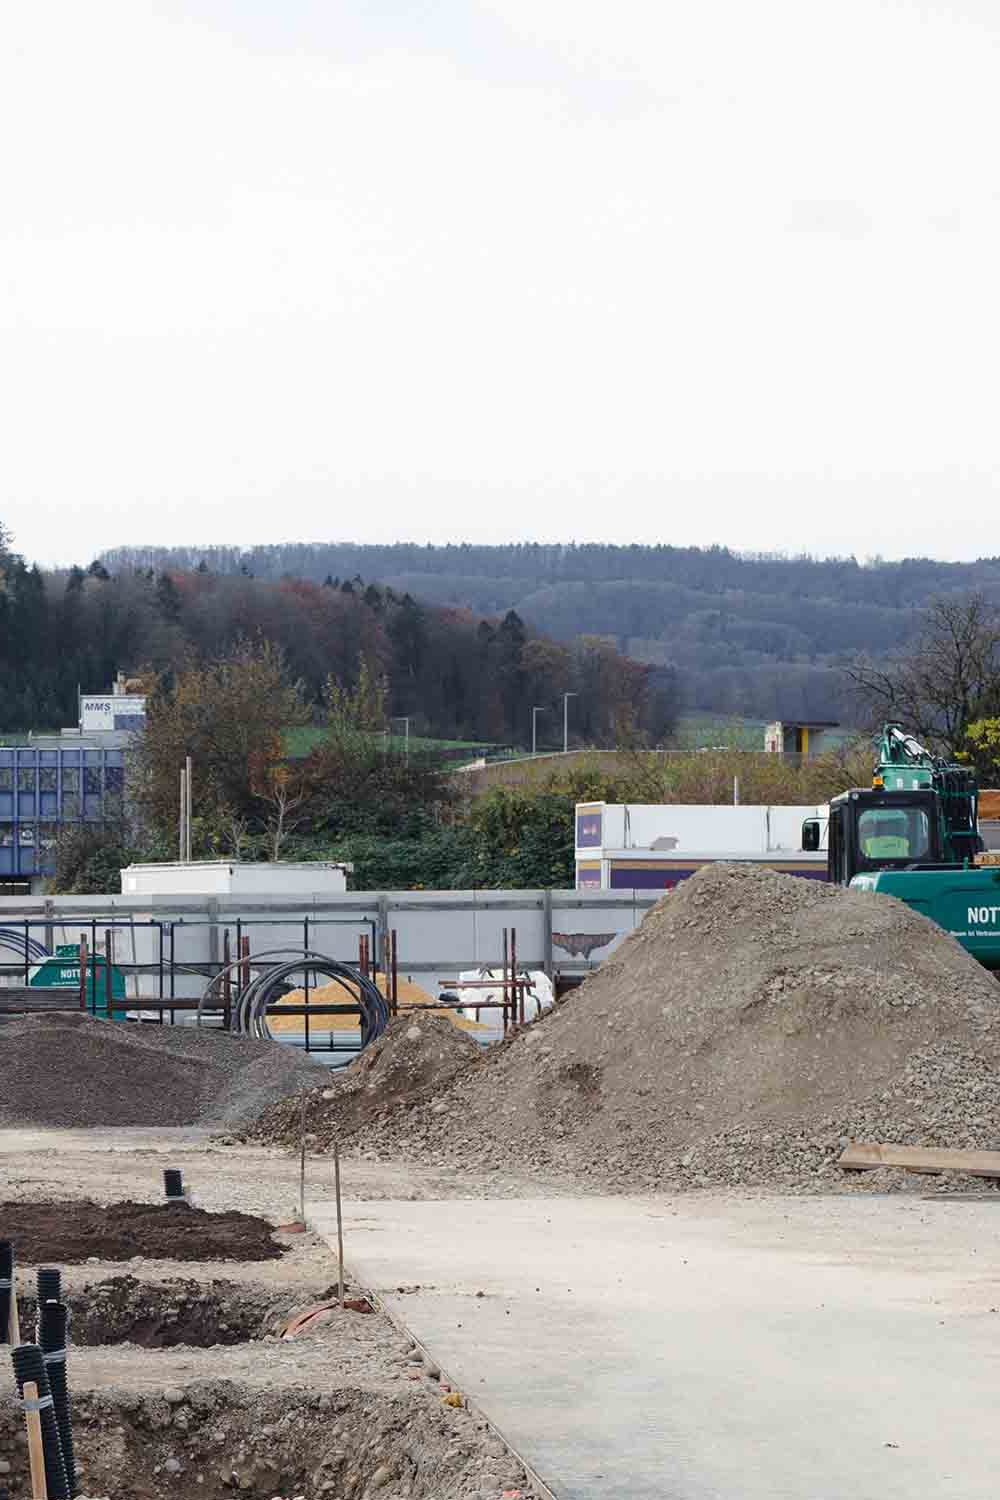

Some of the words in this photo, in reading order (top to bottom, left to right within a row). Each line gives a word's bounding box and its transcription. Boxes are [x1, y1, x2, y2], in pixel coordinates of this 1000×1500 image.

[85, 702, 111, 711] MMS
[967, 906, 1000, 924] NOT
[60, 967, 92, 979] NOTTR
